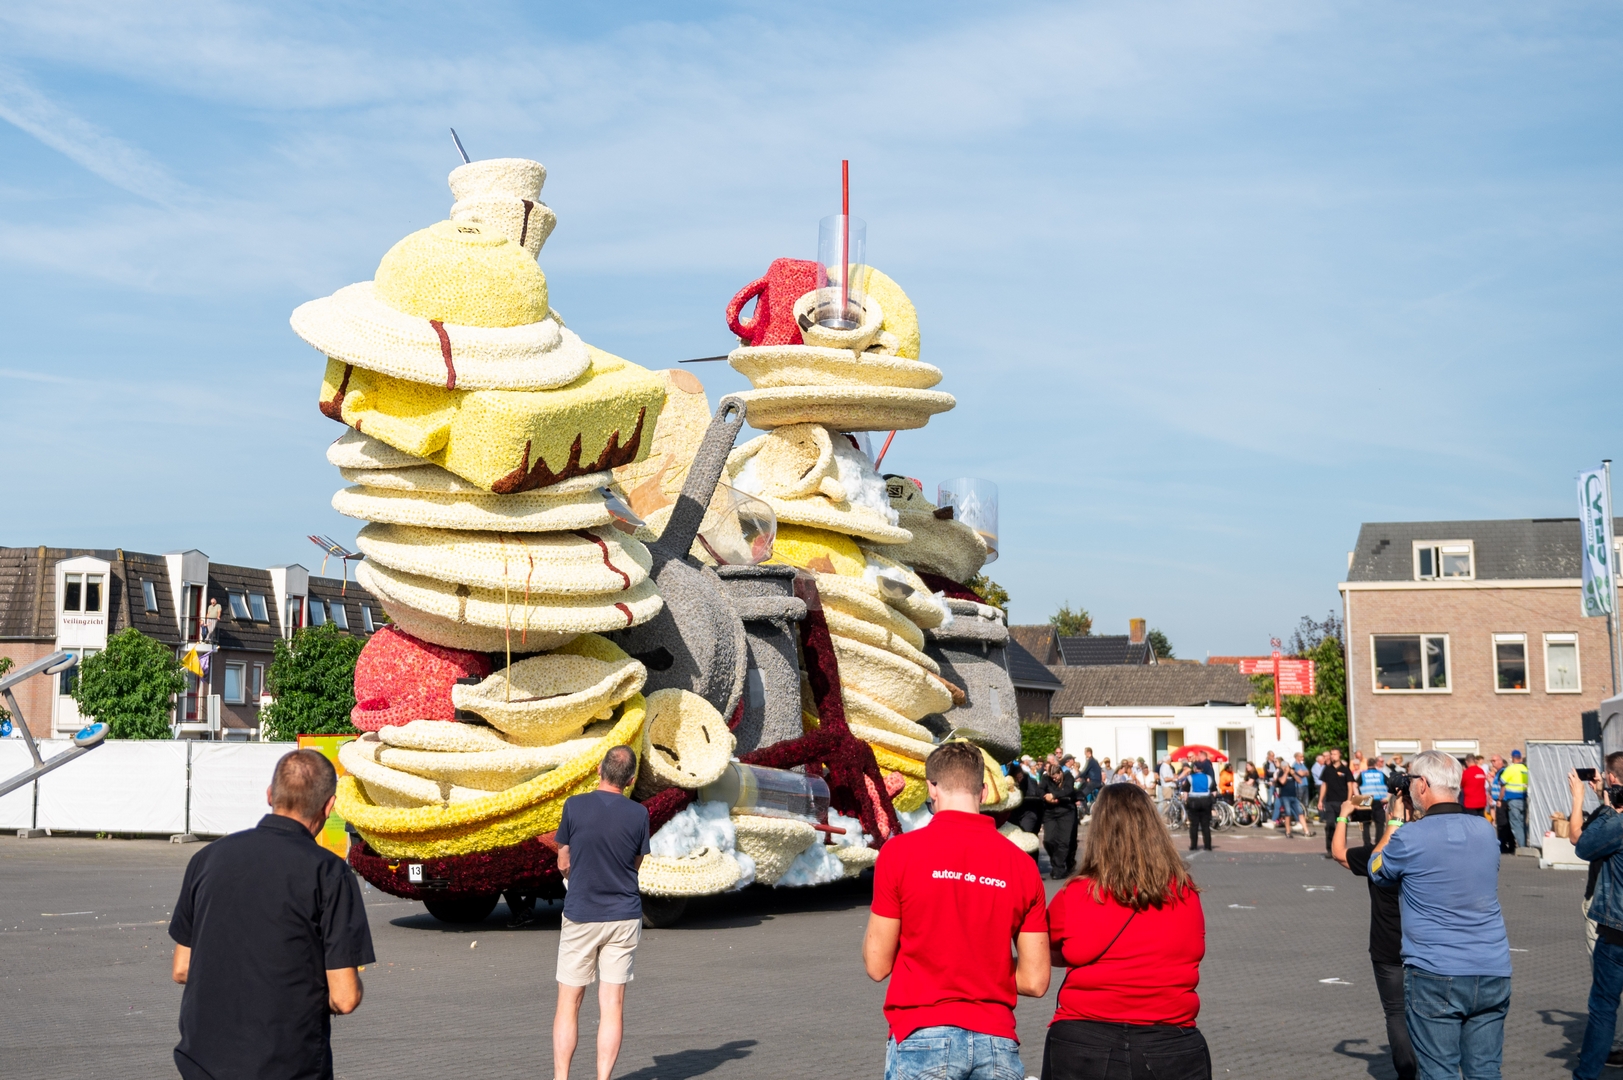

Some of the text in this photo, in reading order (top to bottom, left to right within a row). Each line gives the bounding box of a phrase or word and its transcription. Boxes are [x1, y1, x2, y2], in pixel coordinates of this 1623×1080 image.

[63, 618, 104, 626] Veilingzicht
[411, 866, 421, 875] 13
[932, 869, 1006, 888] autour de corso
